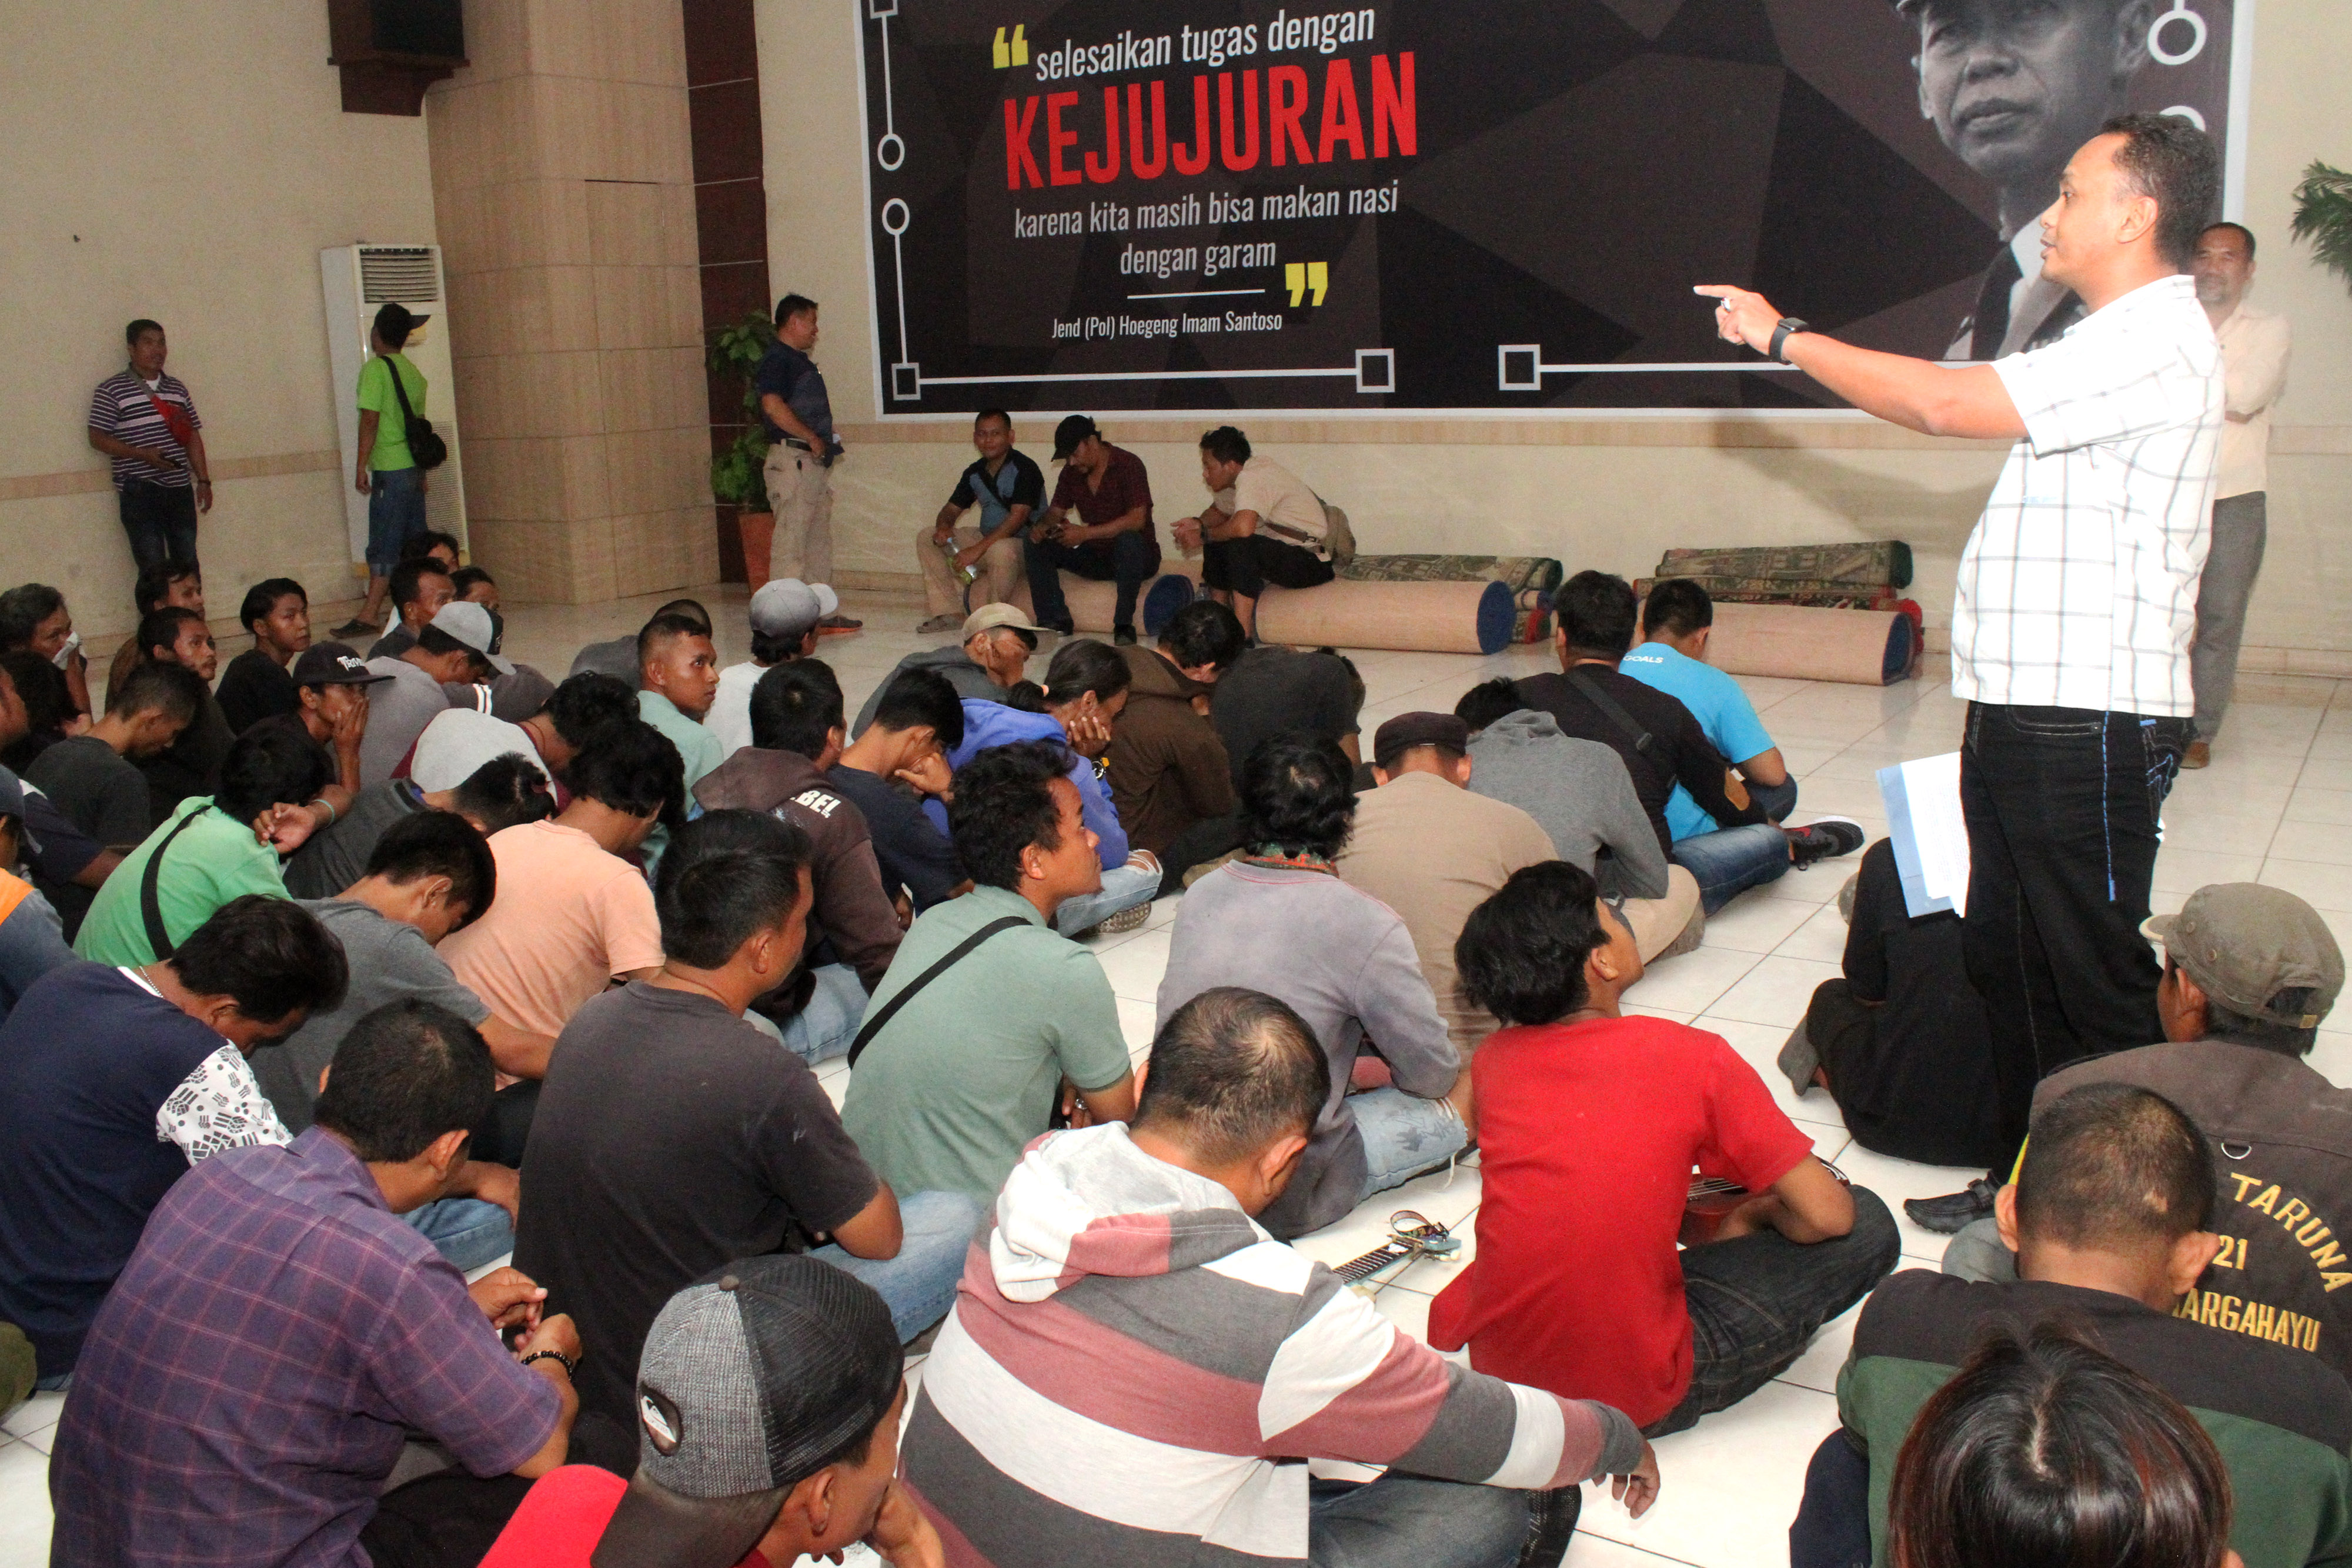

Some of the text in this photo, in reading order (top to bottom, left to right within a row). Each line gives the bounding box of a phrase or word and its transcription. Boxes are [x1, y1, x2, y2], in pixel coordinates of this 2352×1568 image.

[1036, 9, 1375, 81] selesaikan tugas dengan
[1004, 51, 1417, 190] KEJUJURAN
[1015, 179, 1398, 238] karena kita masih bisa makan nasi
[1120, 242, 1276, 278] dengan garam
[1052, 310, 1282, 340] Jend (Pol) Hoegeng Imam Santoso
[2230, 1172, 2352, 1293] TARUNA
[2171, 1288, 2321, 1353] ARGAHAYU
